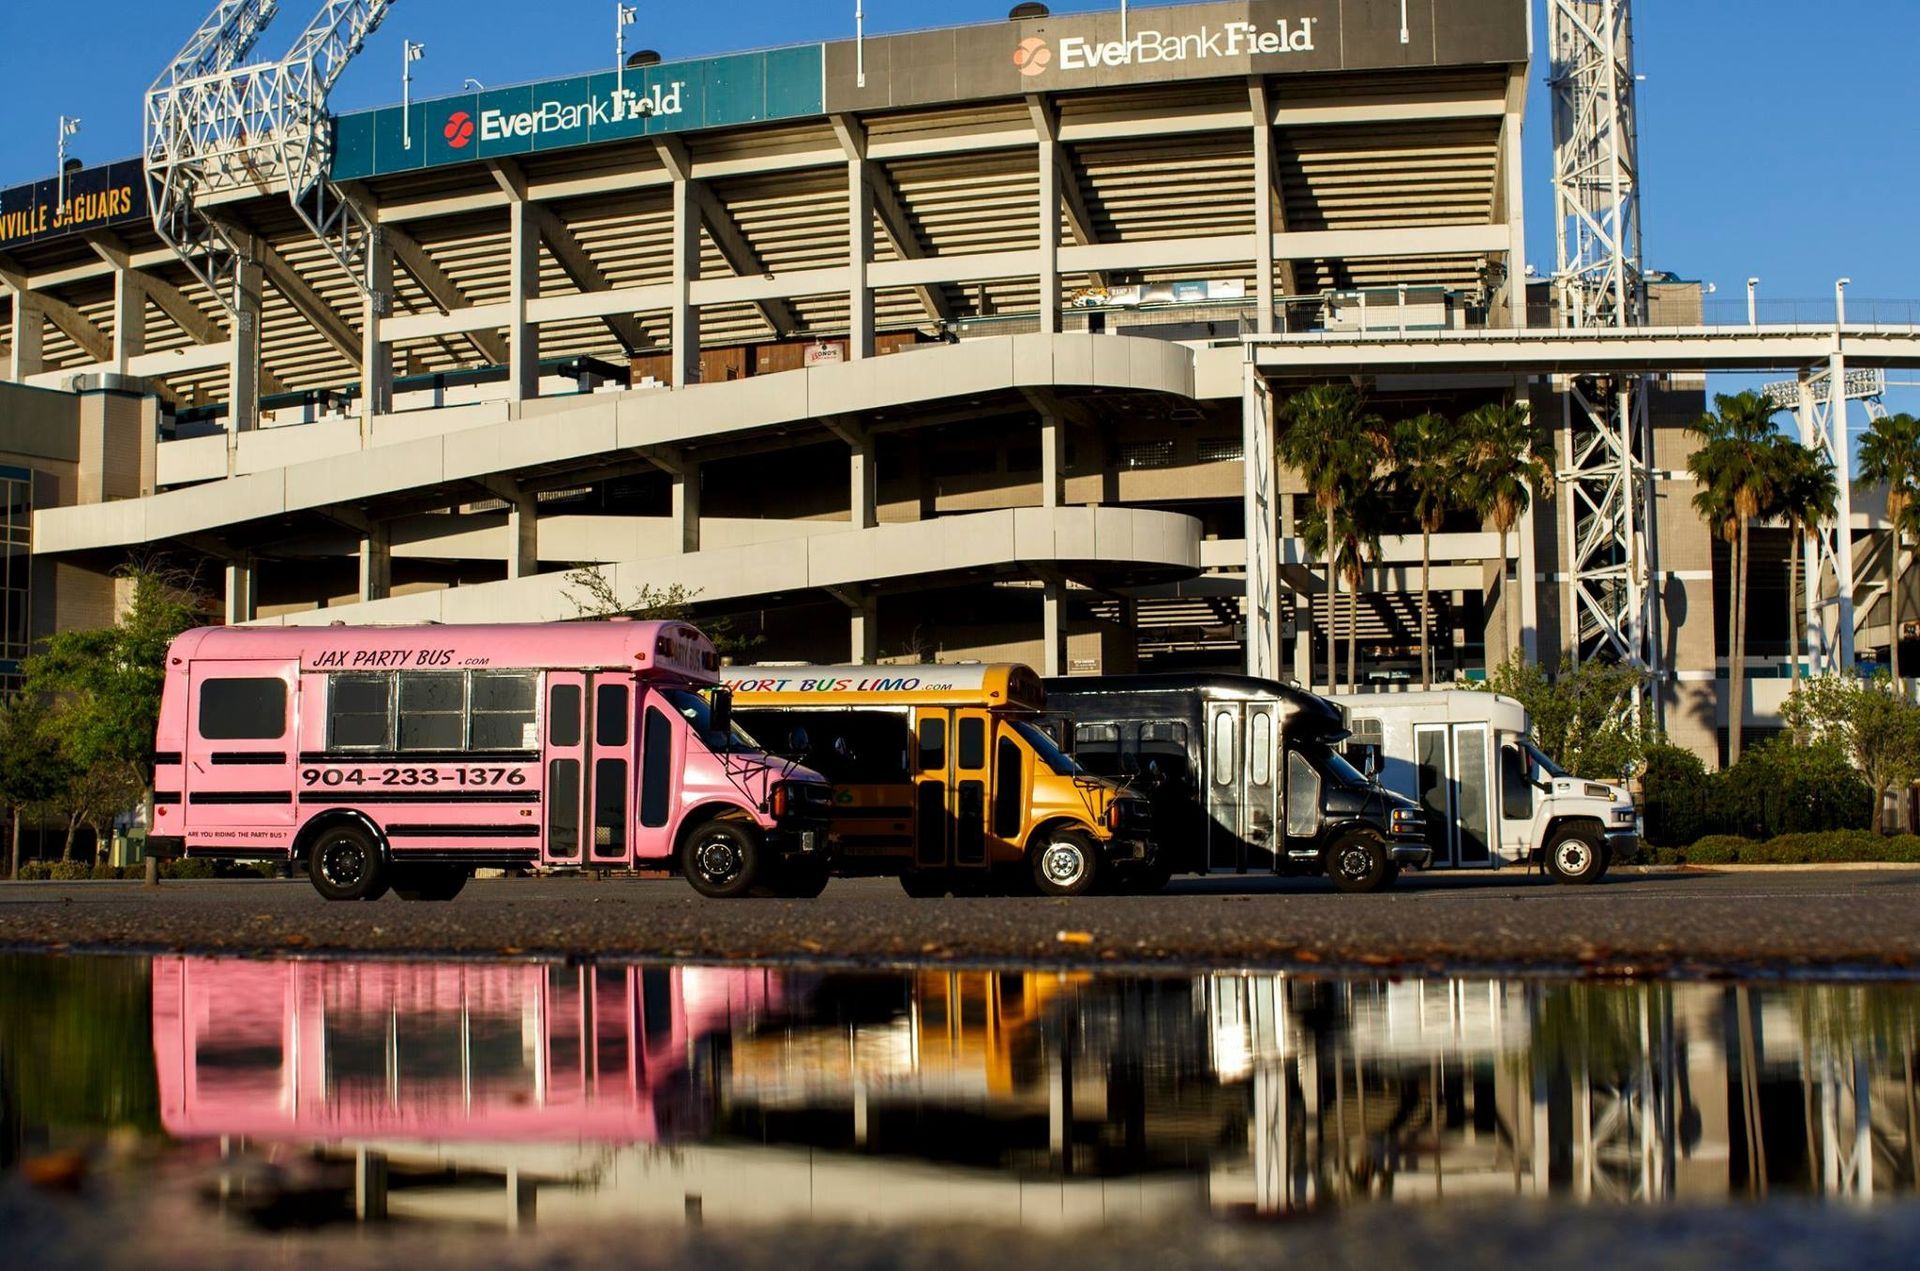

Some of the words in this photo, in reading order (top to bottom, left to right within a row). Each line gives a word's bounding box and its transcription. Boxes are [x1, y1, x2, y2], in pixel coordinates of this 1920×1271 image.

[1224, 17, 1315, 56] Field
[53, 186, 132, 229] JAGUARS
[312, 650, 349, 667] JAX
[352, 650, 413, 666] PARTY
[416, 649, 455, 666] BUS
[720, 679, 792, 692] HORT
[800, 678, 852, 692] BUS
[857, 678, 921, 692] LIMO
[302, 768, 526, 786] 904-233-1376
